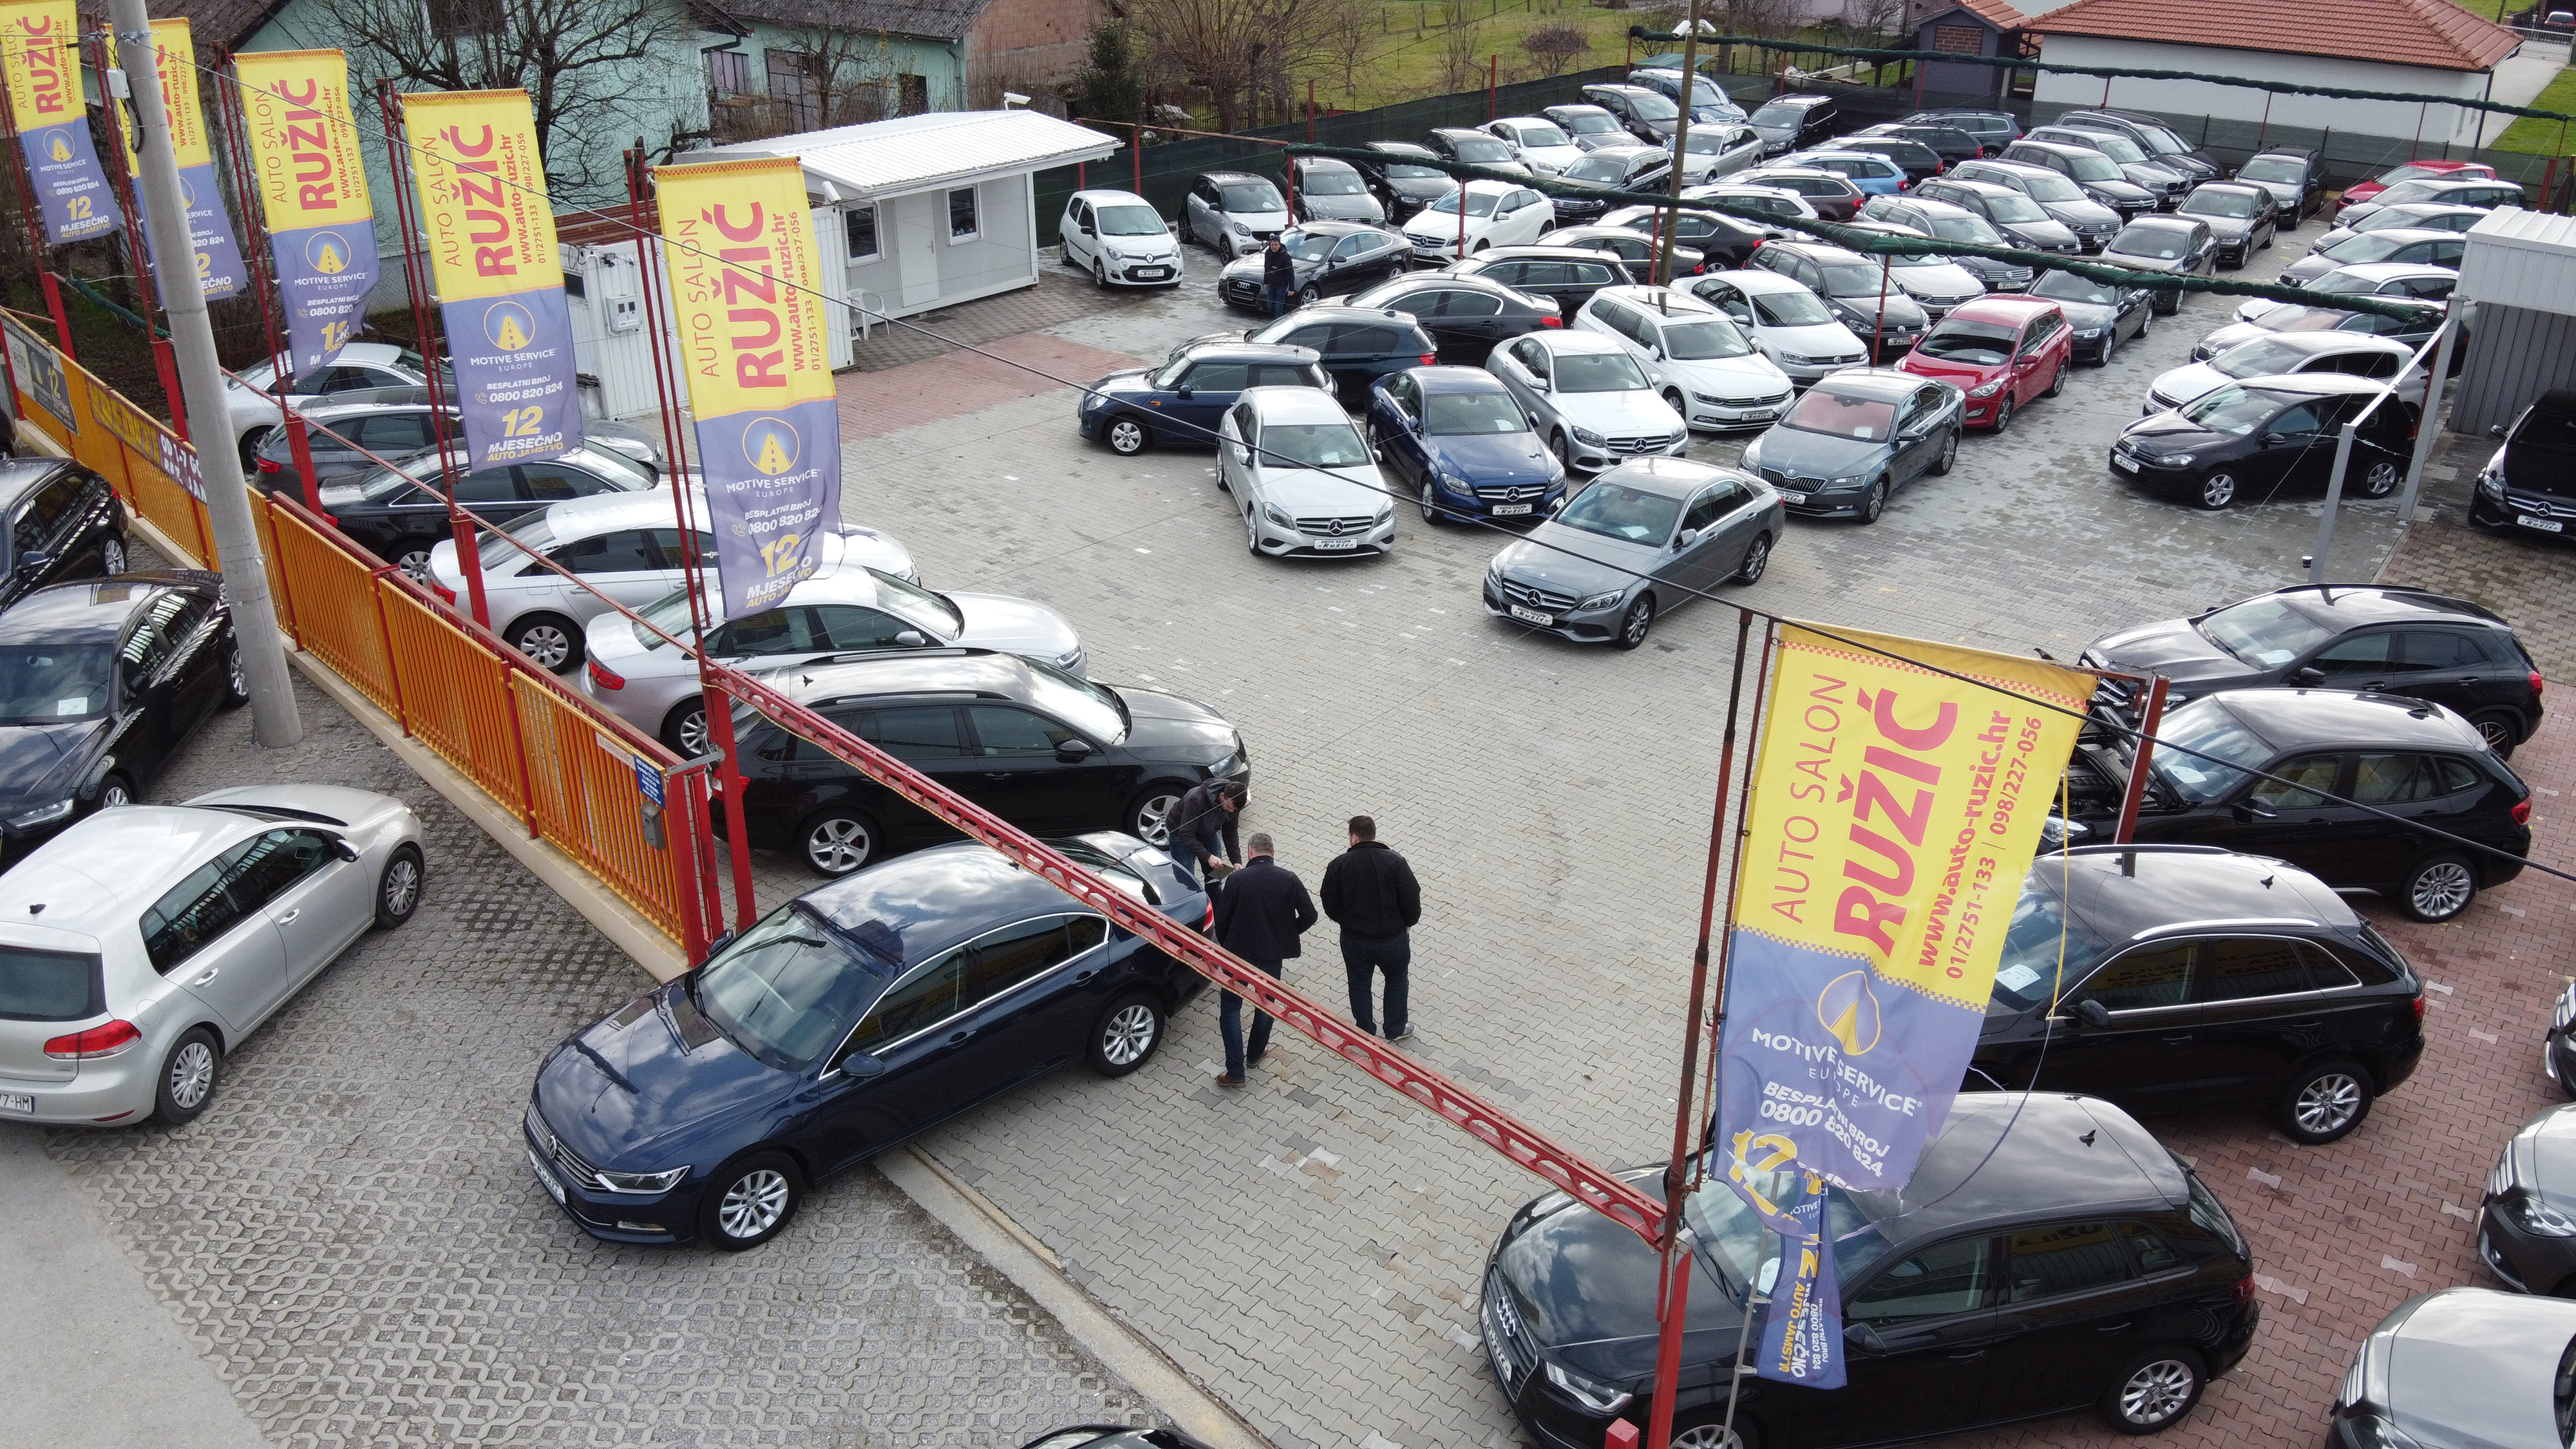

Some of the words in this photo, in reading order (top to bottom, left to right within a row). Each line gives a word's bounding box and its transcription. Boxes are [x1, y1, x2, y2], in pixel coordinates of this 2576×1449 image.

[4, 24, 20, 68] SALON
[16, 15, 64, 114] RUŽIĆ
[13, 72, 28, 108] AUTO
[180, 50, 189, 94] 098/227-056
[169, 52, 187, 147] www.auto-ruzic.hr
[334, 86, 349, 138] 098227-056
[184, 102, 196, 146] 01/2751-133
[255, 90, 278, 149] SALON
[270, 77, 338, 211] RUŽIĆ
[516, 133, 535, 194] 098/227-056
[57, 186, 73, 196] 0800
[73, 184, 88, 193] 820
[88, 181, 99, 190] 824
[266, 156, 287, 203] AUTO
[345, 147, 362, 198] 01/2751-133
[421, 136, 449, 205] SALON
[67, 196, 93, 221] 12
[188, 209, 213, 219] ERVICE
[440, 124, 518, 278] RUŽIĆ
[61, 214, 109, 233] MJESEČNO
[61, 230, 80, 238] AUTO
[81, 222, 111, 235] JAMSTVO
[209, 236, 225, 245] 824
[437, 213, 462, 267] AUTO
[529, 204, 546, 264] 01/2751-133
[677, 219, 708, 303] SALON
[789, 211, 809, 286] 098/227-056
[202, 276, 232, 289] EČNO
[294, 277, 329, 286] MOTIVE
[331, 273, 366, 284] SERVICE
[701, 201, 787, 389] RUŽIĆ
[771, 213, 804, 372] www.auto-ruzic.hr
[307, 297, 346, 307] BESPLATNI
[310, 307, 337, 317] 0800
[338, 304, 354, 314] 820
[691, 312, 720, 377] AUTO
[804, 299, 820, 371] 01/2751-133
[470, 354, 511, 366] MOTIVE
[514, 350, 555, 362] SERVICE
[498, 362, 533, 372] EUROPE
[487, 379, 531, 390] BESPLATNI
[531, 375, 551, 385] BROJ
[489, 390, 520, 402] 0800
[522, 386, 544, 399] 820
[545, 381, 563, 395] 824
[502, 405, 544, 438] 12
[160, 433, 173, 456] OD
[487, 451, 516, 462] AUTO
[517, 442, 564, 458] JAMSTVO
[488, 431, 563, 453] MJESEČNO
[726, 479, 772, 493] MOTIVE
[774, 468, 818, 487] SERVICE
[756, 487, 794, 498] EUROPE
[744, 504, 790, 520] BESPLATNI
[790, 498, 811, 511] BROJ
[748, 518, 777, 535] 0800
[779, 513, 802, 526] 820
[760, 534, 800, 578] 12
[746, 589, 775, 608] AUTO
[1789, 674, 1848, 804] SALON
[1833, 687, 1958, 958] RUŽIĆ
[1919, 710, 2012, 967] www.auto-ruzic.hr
[1947, 857, 1997, 980] 01/2751-133
[1989, 717, 2043, 835] 098/227-056
[1771, 816, 1820, 925] AUTO
[1752, 1028, 1837, 1065] MOTIVE
[0, 1094, 30, 1111] 7-HM
[1763, 1081, 1850, 1130] BESPLATNI
[1848, 1122, 1890, 1158] BROJ
[1760, 1099, 1823, 1126] 0800
[1824, 1116, 1852, 1150] 820
[1852, 1146, 1882, 1178] 824
[1790, 1280, 1806, 1319] AUTO
[1810, 1303, 1819, 1331] 0800
[1812, 1332, 1820, 1352] 820
[1812, 1354, 1821, 1370] 824
